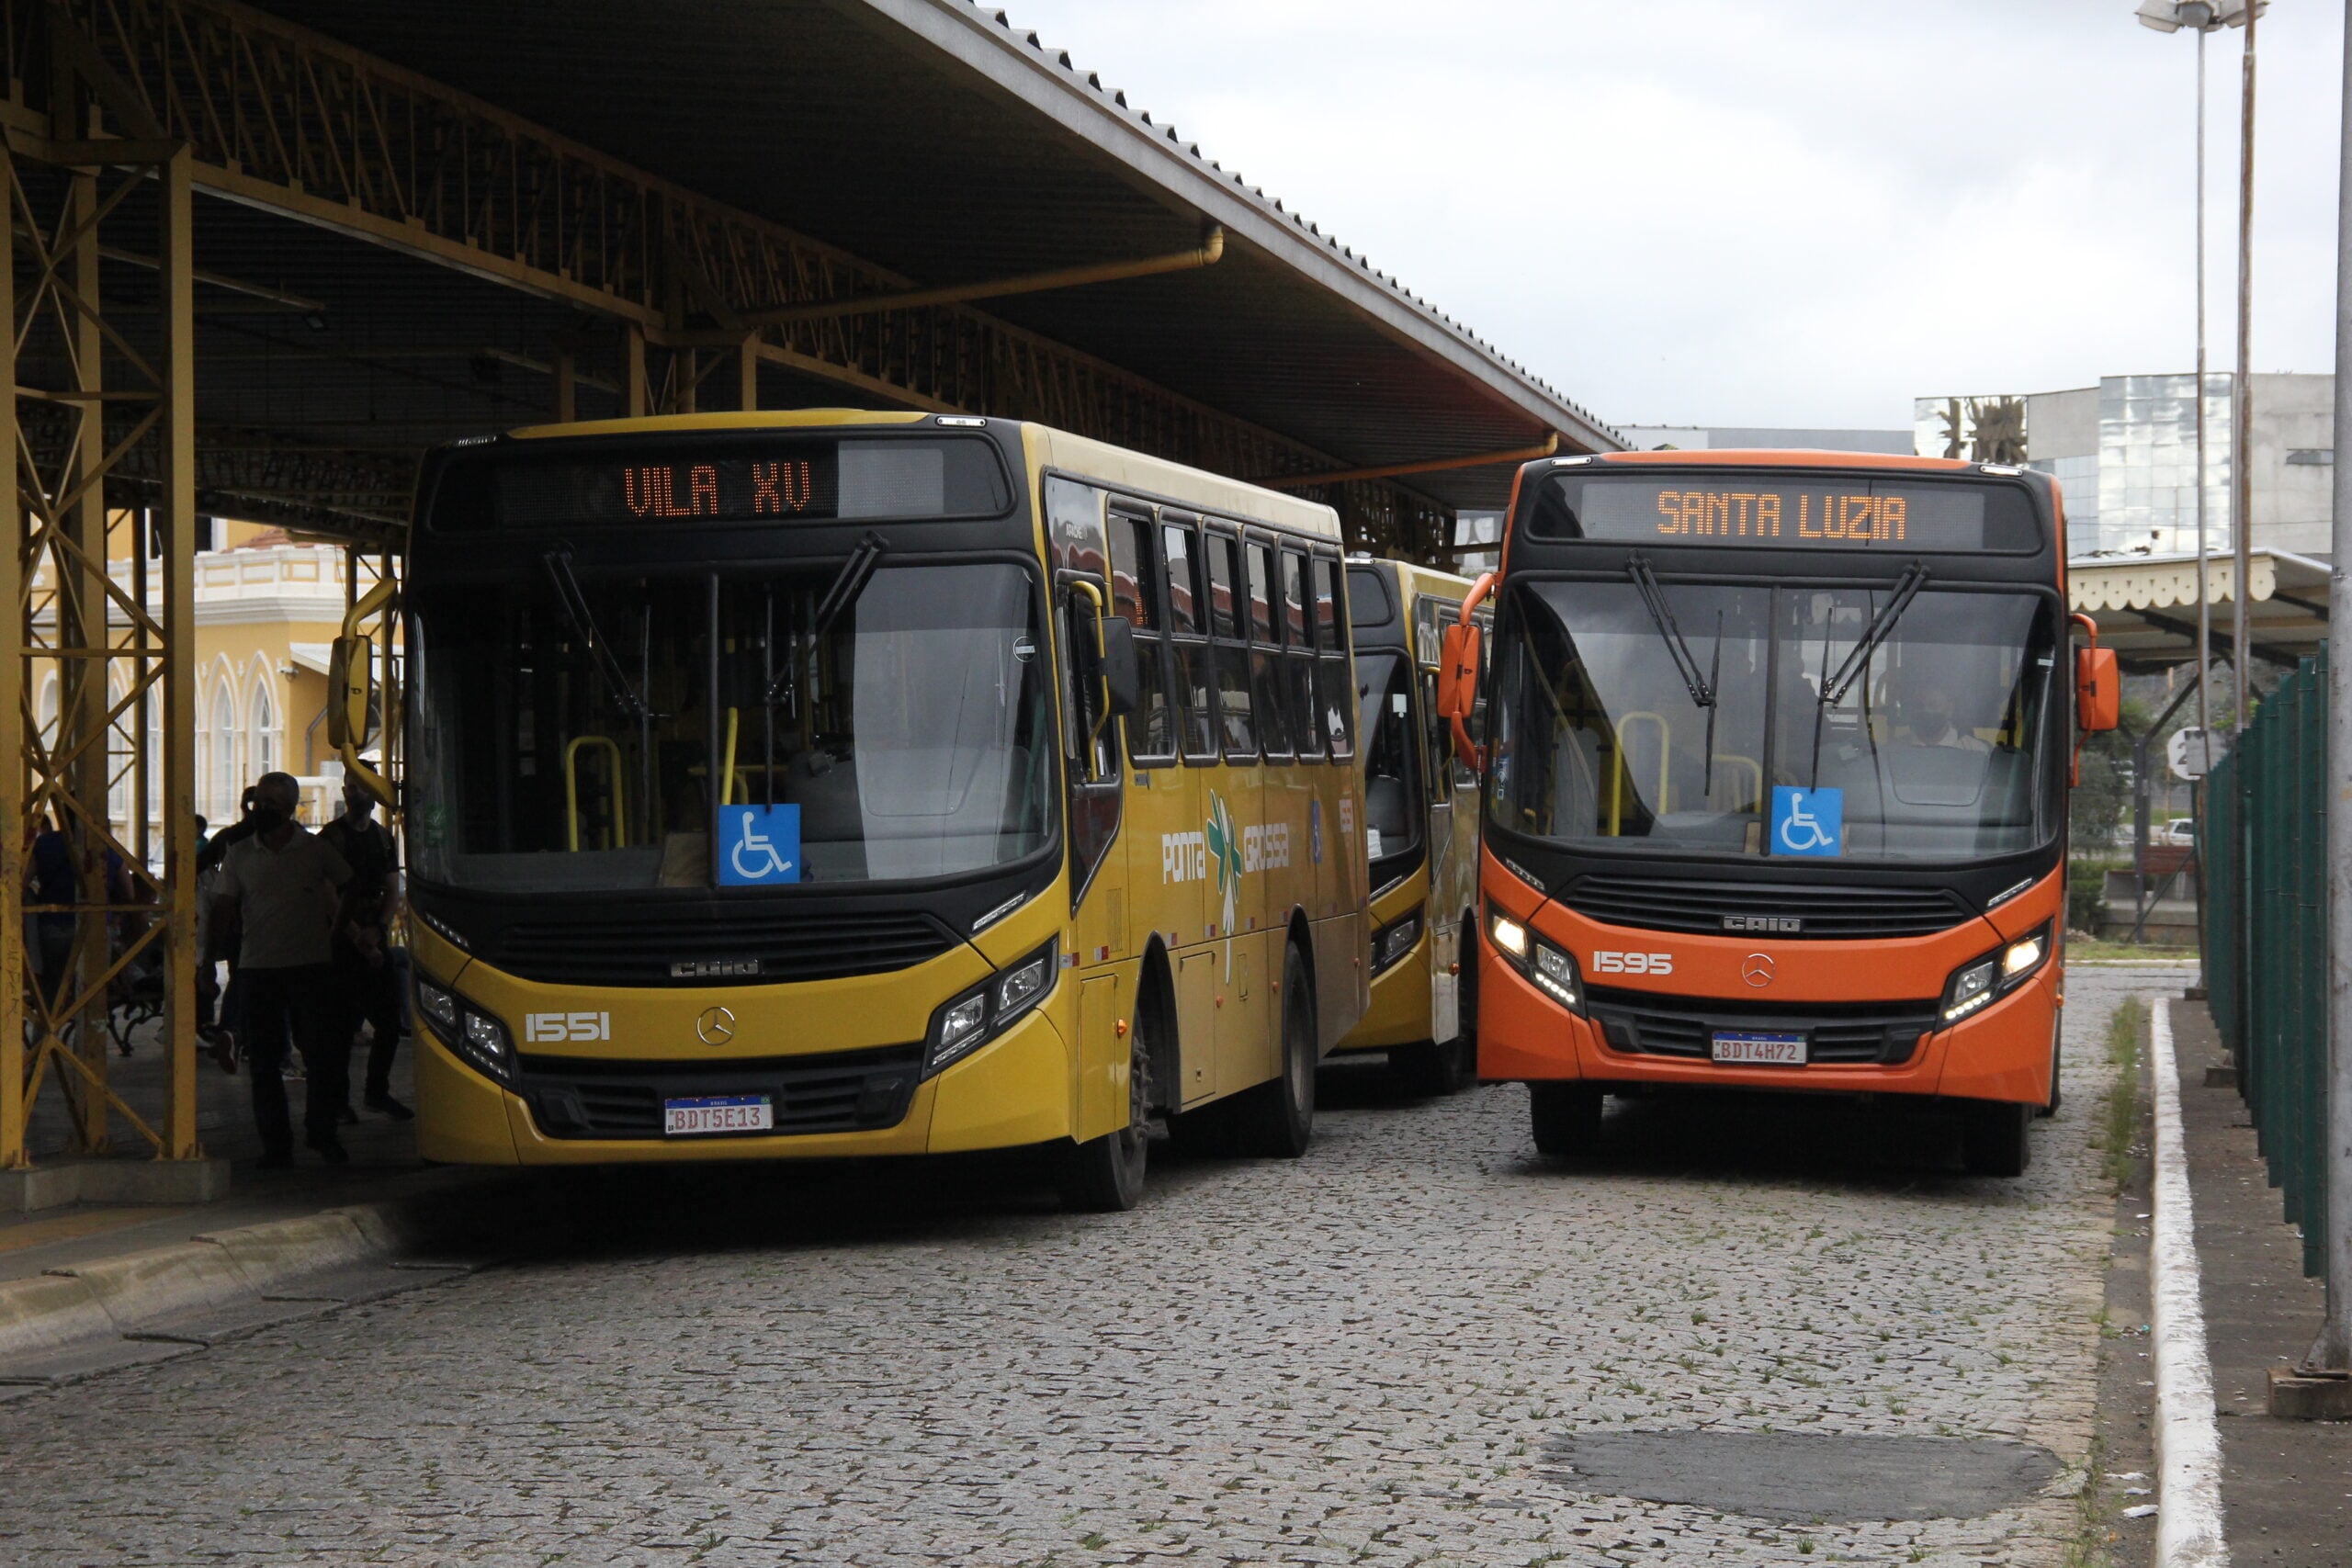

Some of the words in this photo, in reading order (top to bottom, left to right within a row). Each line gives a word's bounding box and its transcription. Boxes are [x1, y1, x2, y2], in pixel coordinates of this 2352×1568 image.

[625, 466, 718, 516] VILA
[752, 462, 810, 513] XV
[1657, 491, 1781, 536] SANTA
[1799, 494, 1906, 540] LUZIA
[1724, 916, 1801, 932] CAIO
[671, 960, 759, 977] CAIO
[1593, 951, 1673, 976] 1595
[526, 1011, 610, 1043] 1551
[1721, 1042, 1796, 1060] BDT4H72
[675, 1107, 761, 1131] BDT5E13
